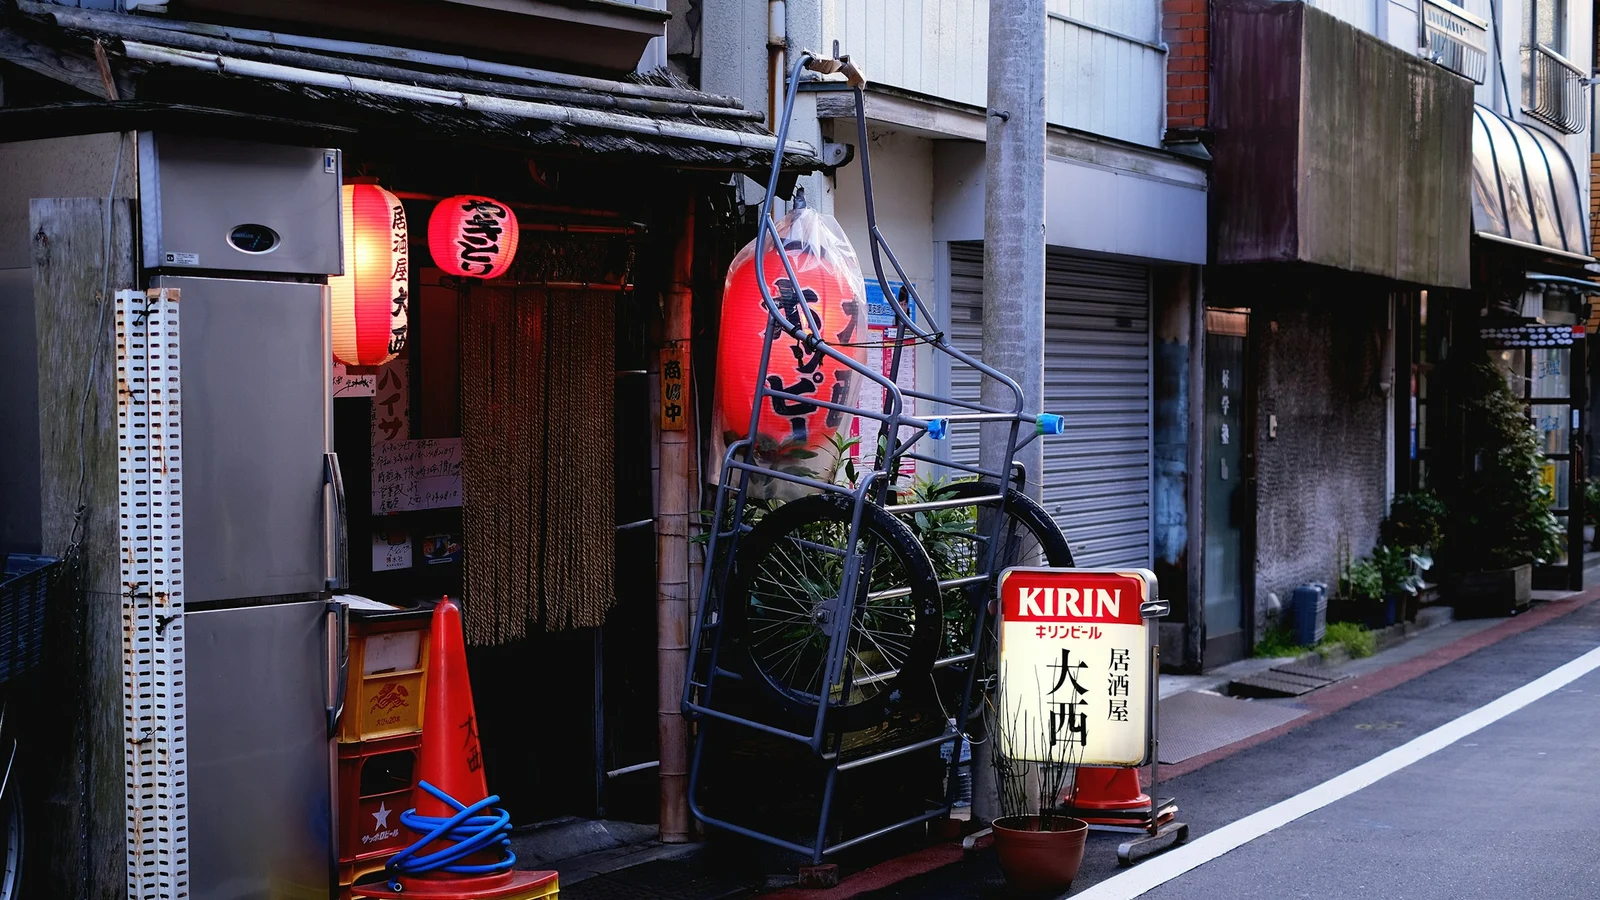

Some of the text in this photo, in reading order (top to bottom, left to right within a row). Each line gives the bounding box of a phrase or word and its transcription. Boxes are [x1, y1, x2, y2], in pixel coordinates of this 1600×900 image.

[456, 199, 507, 276] やきとり
[664, 360, 682, 423] 商い中
[1018, 587, 1122, 618] KIRIN
[1036, 625, 1102, 640] キリンビール
[1046, 647, 1090, 747] 大西
[1107, 648, 1131, 722] 居酒屋
[361, 828, 399, 844] サッポロビール
